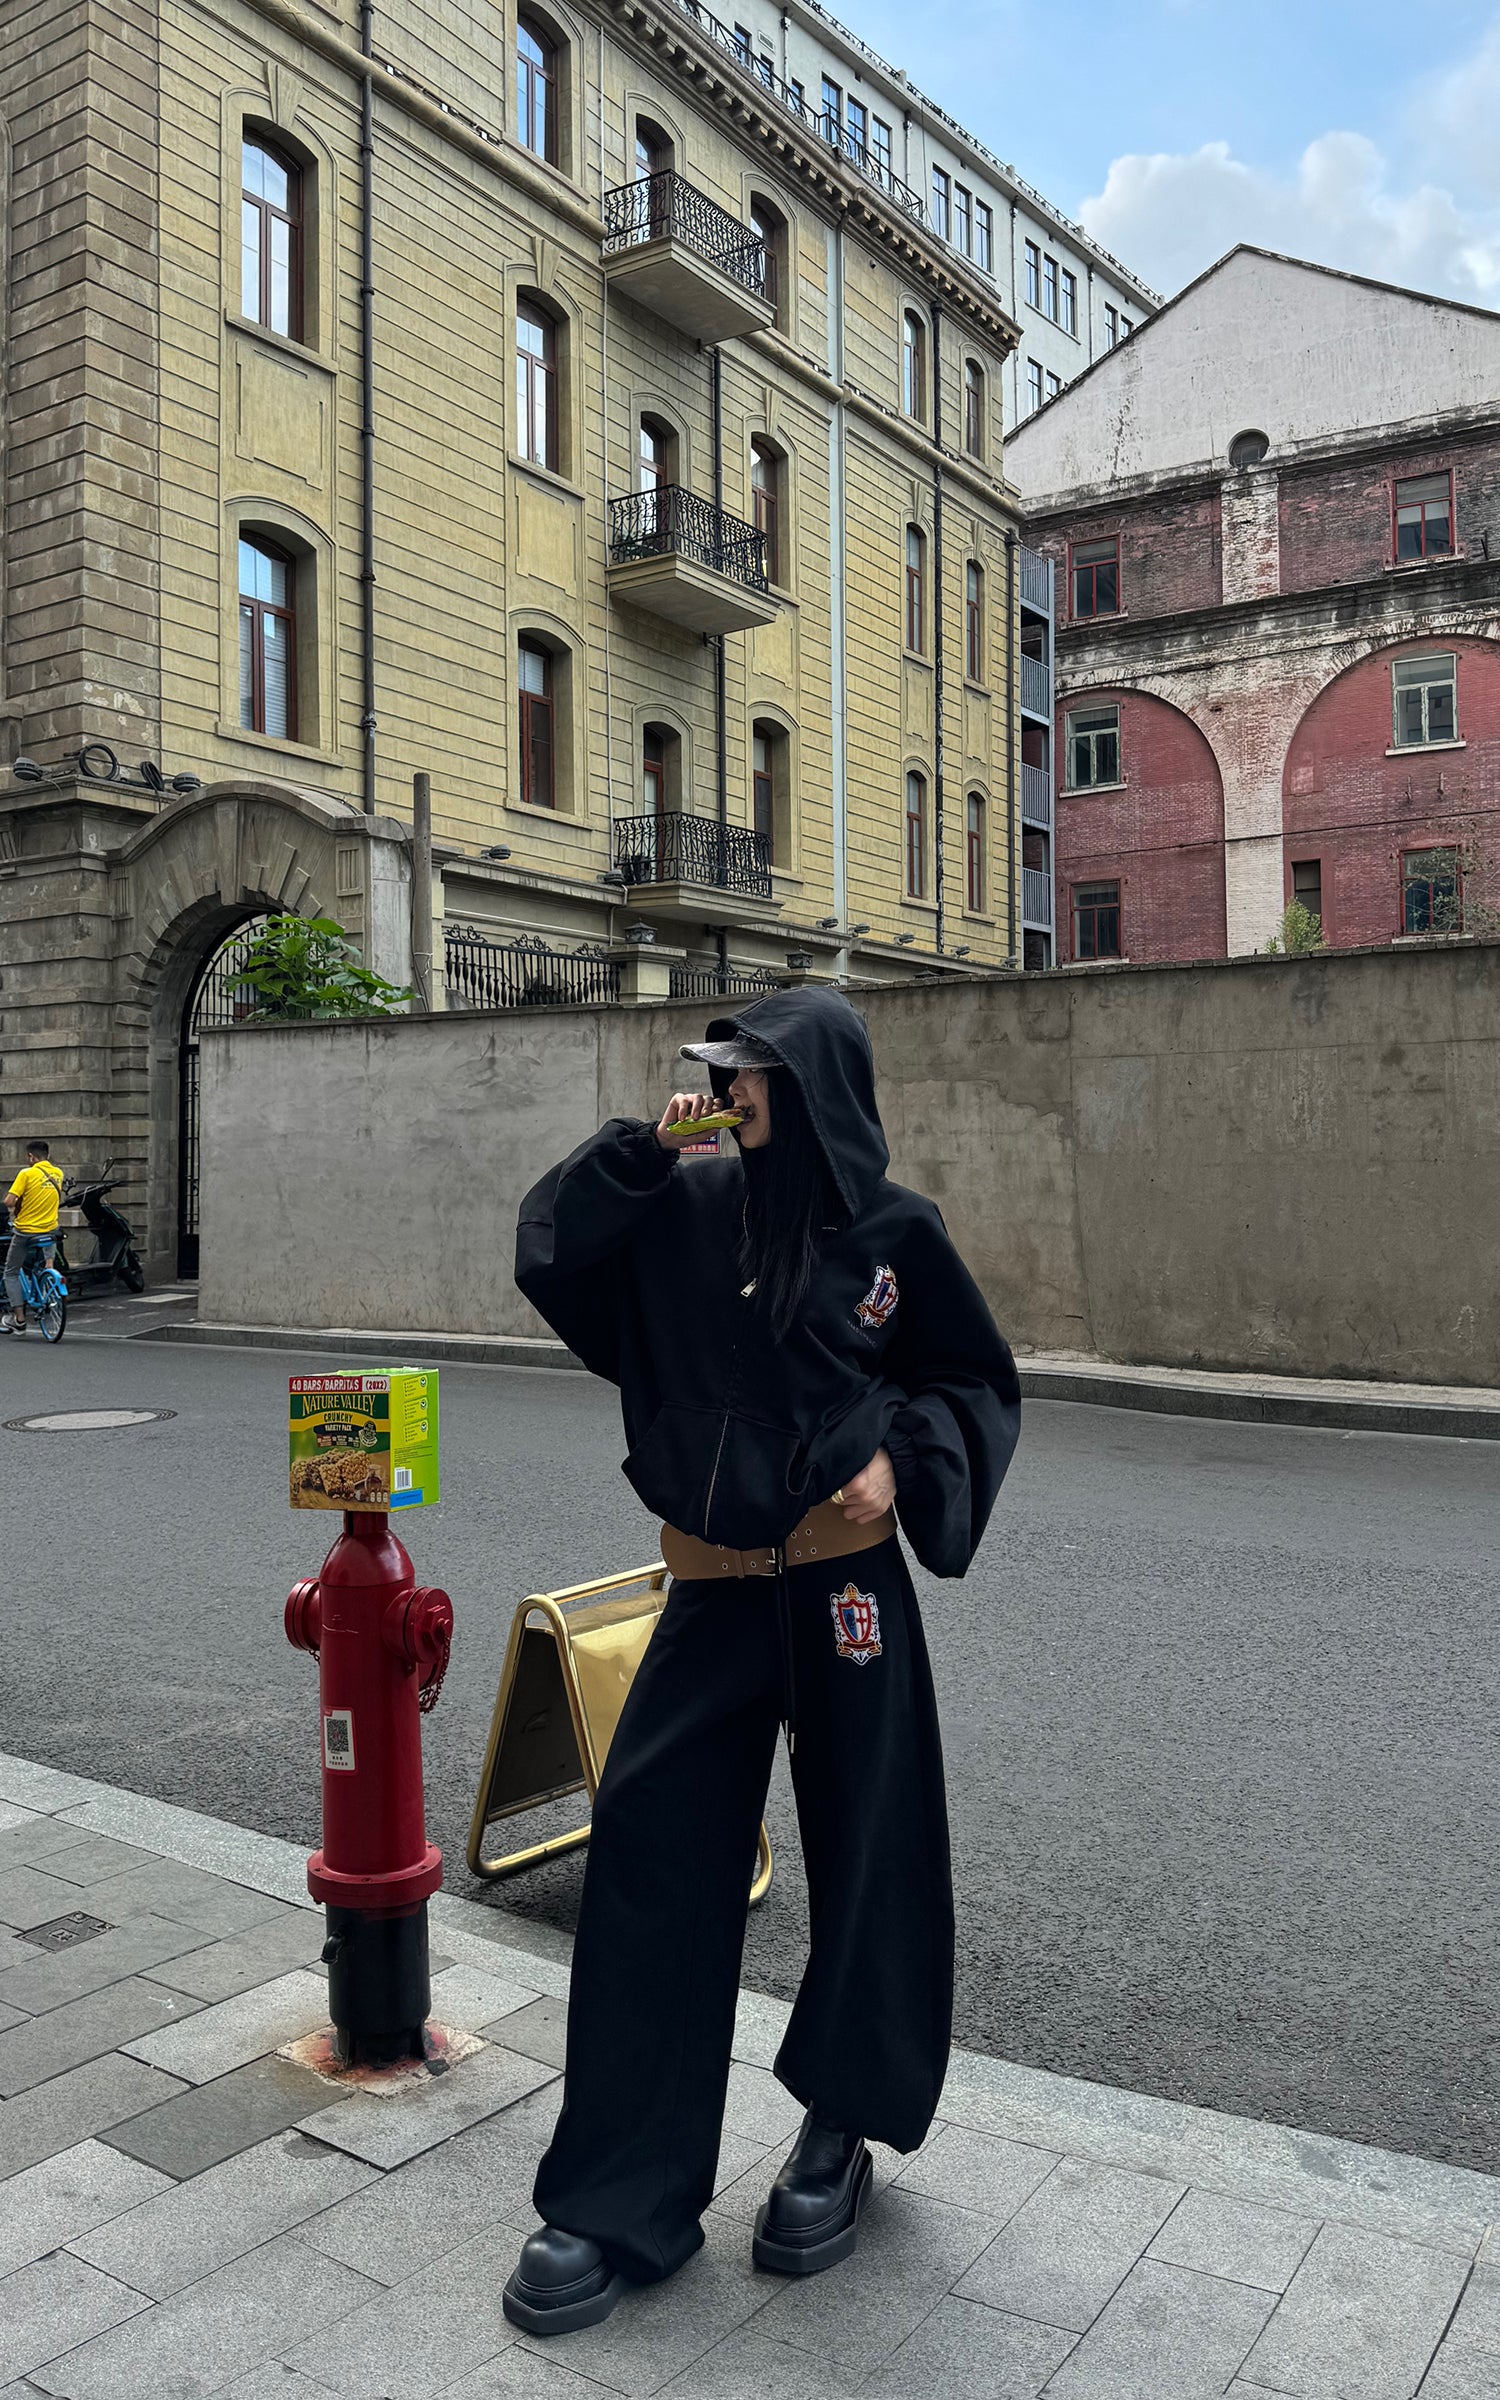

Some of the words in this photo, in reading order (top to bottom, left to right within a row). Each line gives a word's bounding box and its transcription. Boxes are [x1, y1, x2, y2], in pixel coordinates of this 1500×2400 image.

[291, 1380, 302, 1391] 40
[303, 1395, 340, 1416] NATURE
[341, 1395, 376, 1416] VALLEY
[323, 1412, 353, 1423] CRUNCHY
[342, 1424, 353, 1432] PACK
